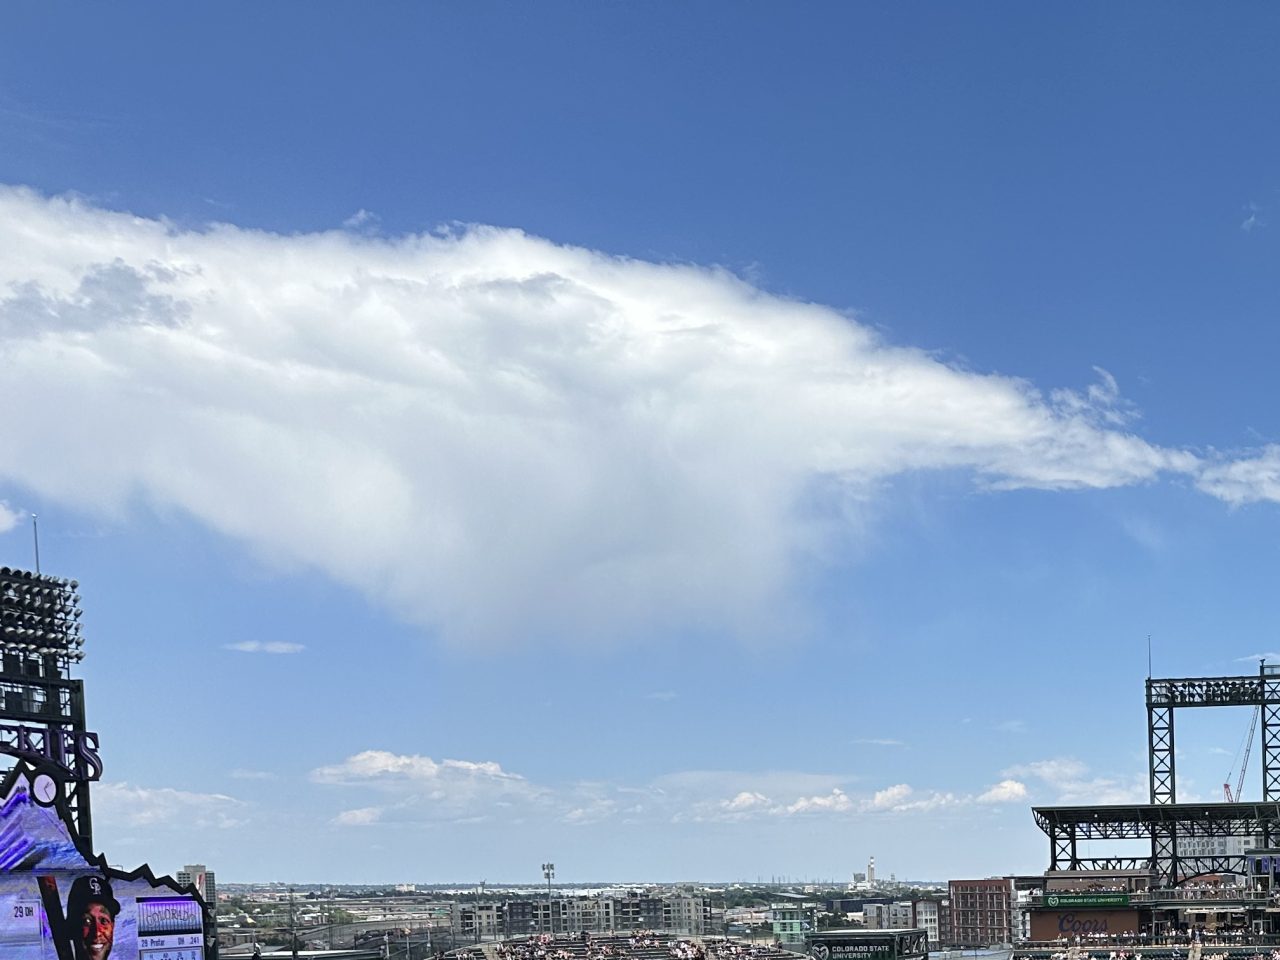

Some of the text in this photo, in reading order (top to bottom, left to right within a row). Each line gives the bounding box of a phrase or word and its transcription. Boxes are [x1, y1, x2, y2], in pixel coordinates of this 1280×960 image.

[14, 906, 24, 918] 29
[146, 908, 197, 928] COLORADO
[1058, 912, 1109, 933] Coors
